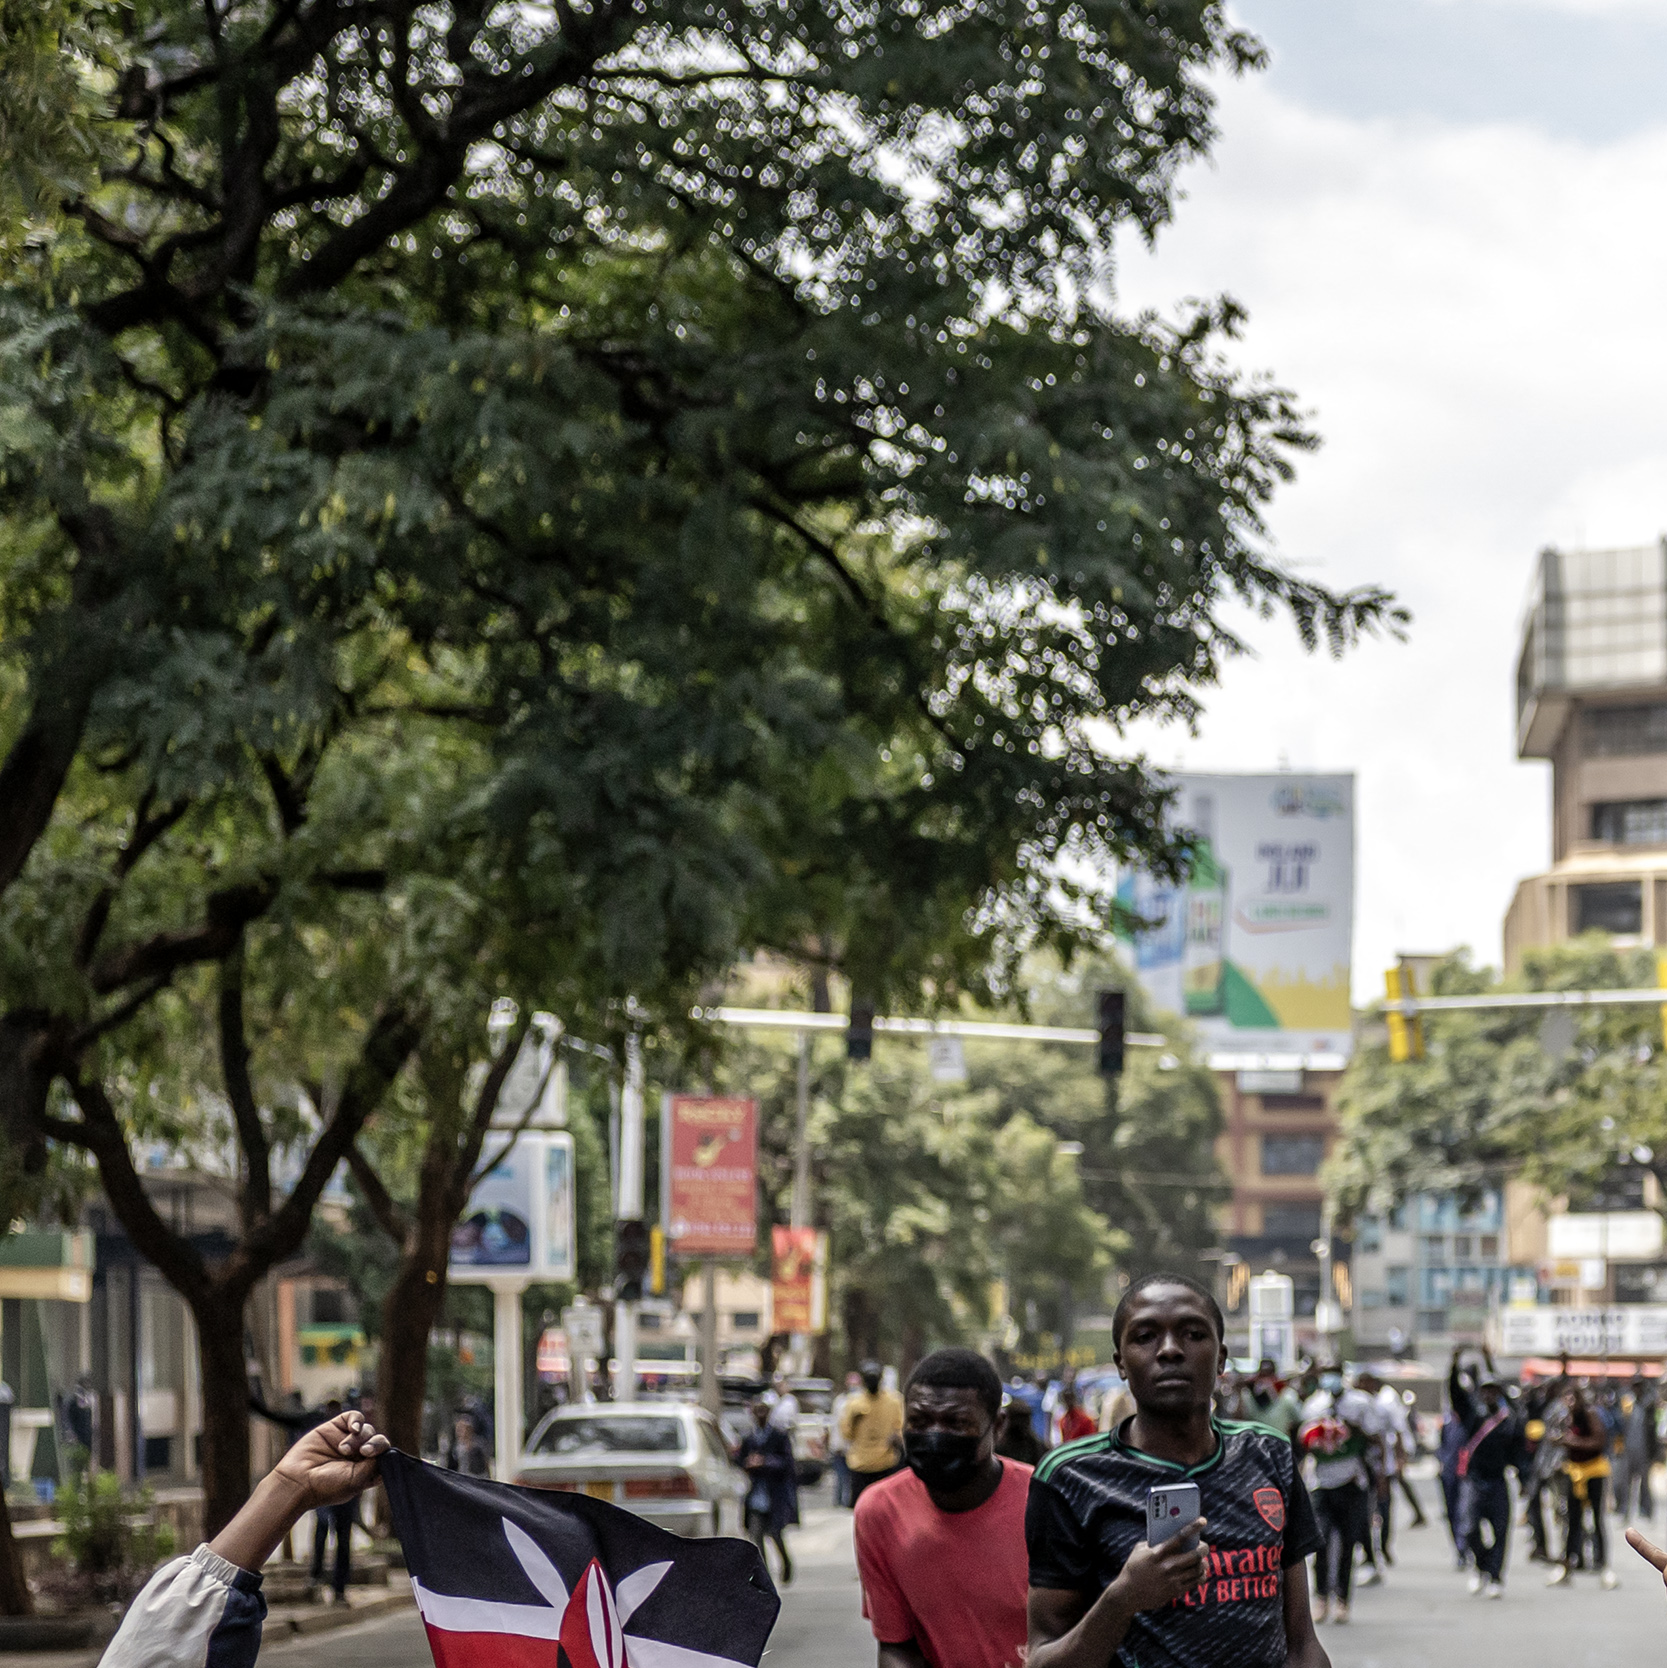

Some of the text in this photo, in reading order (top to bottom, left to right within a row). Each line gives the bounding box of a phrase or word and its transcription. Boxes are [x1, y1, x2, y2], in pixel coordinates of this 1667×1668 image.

[1204, 1544, 1284, 1578] irate
[1171, 1575, 1278, 1608] LY BETTER
